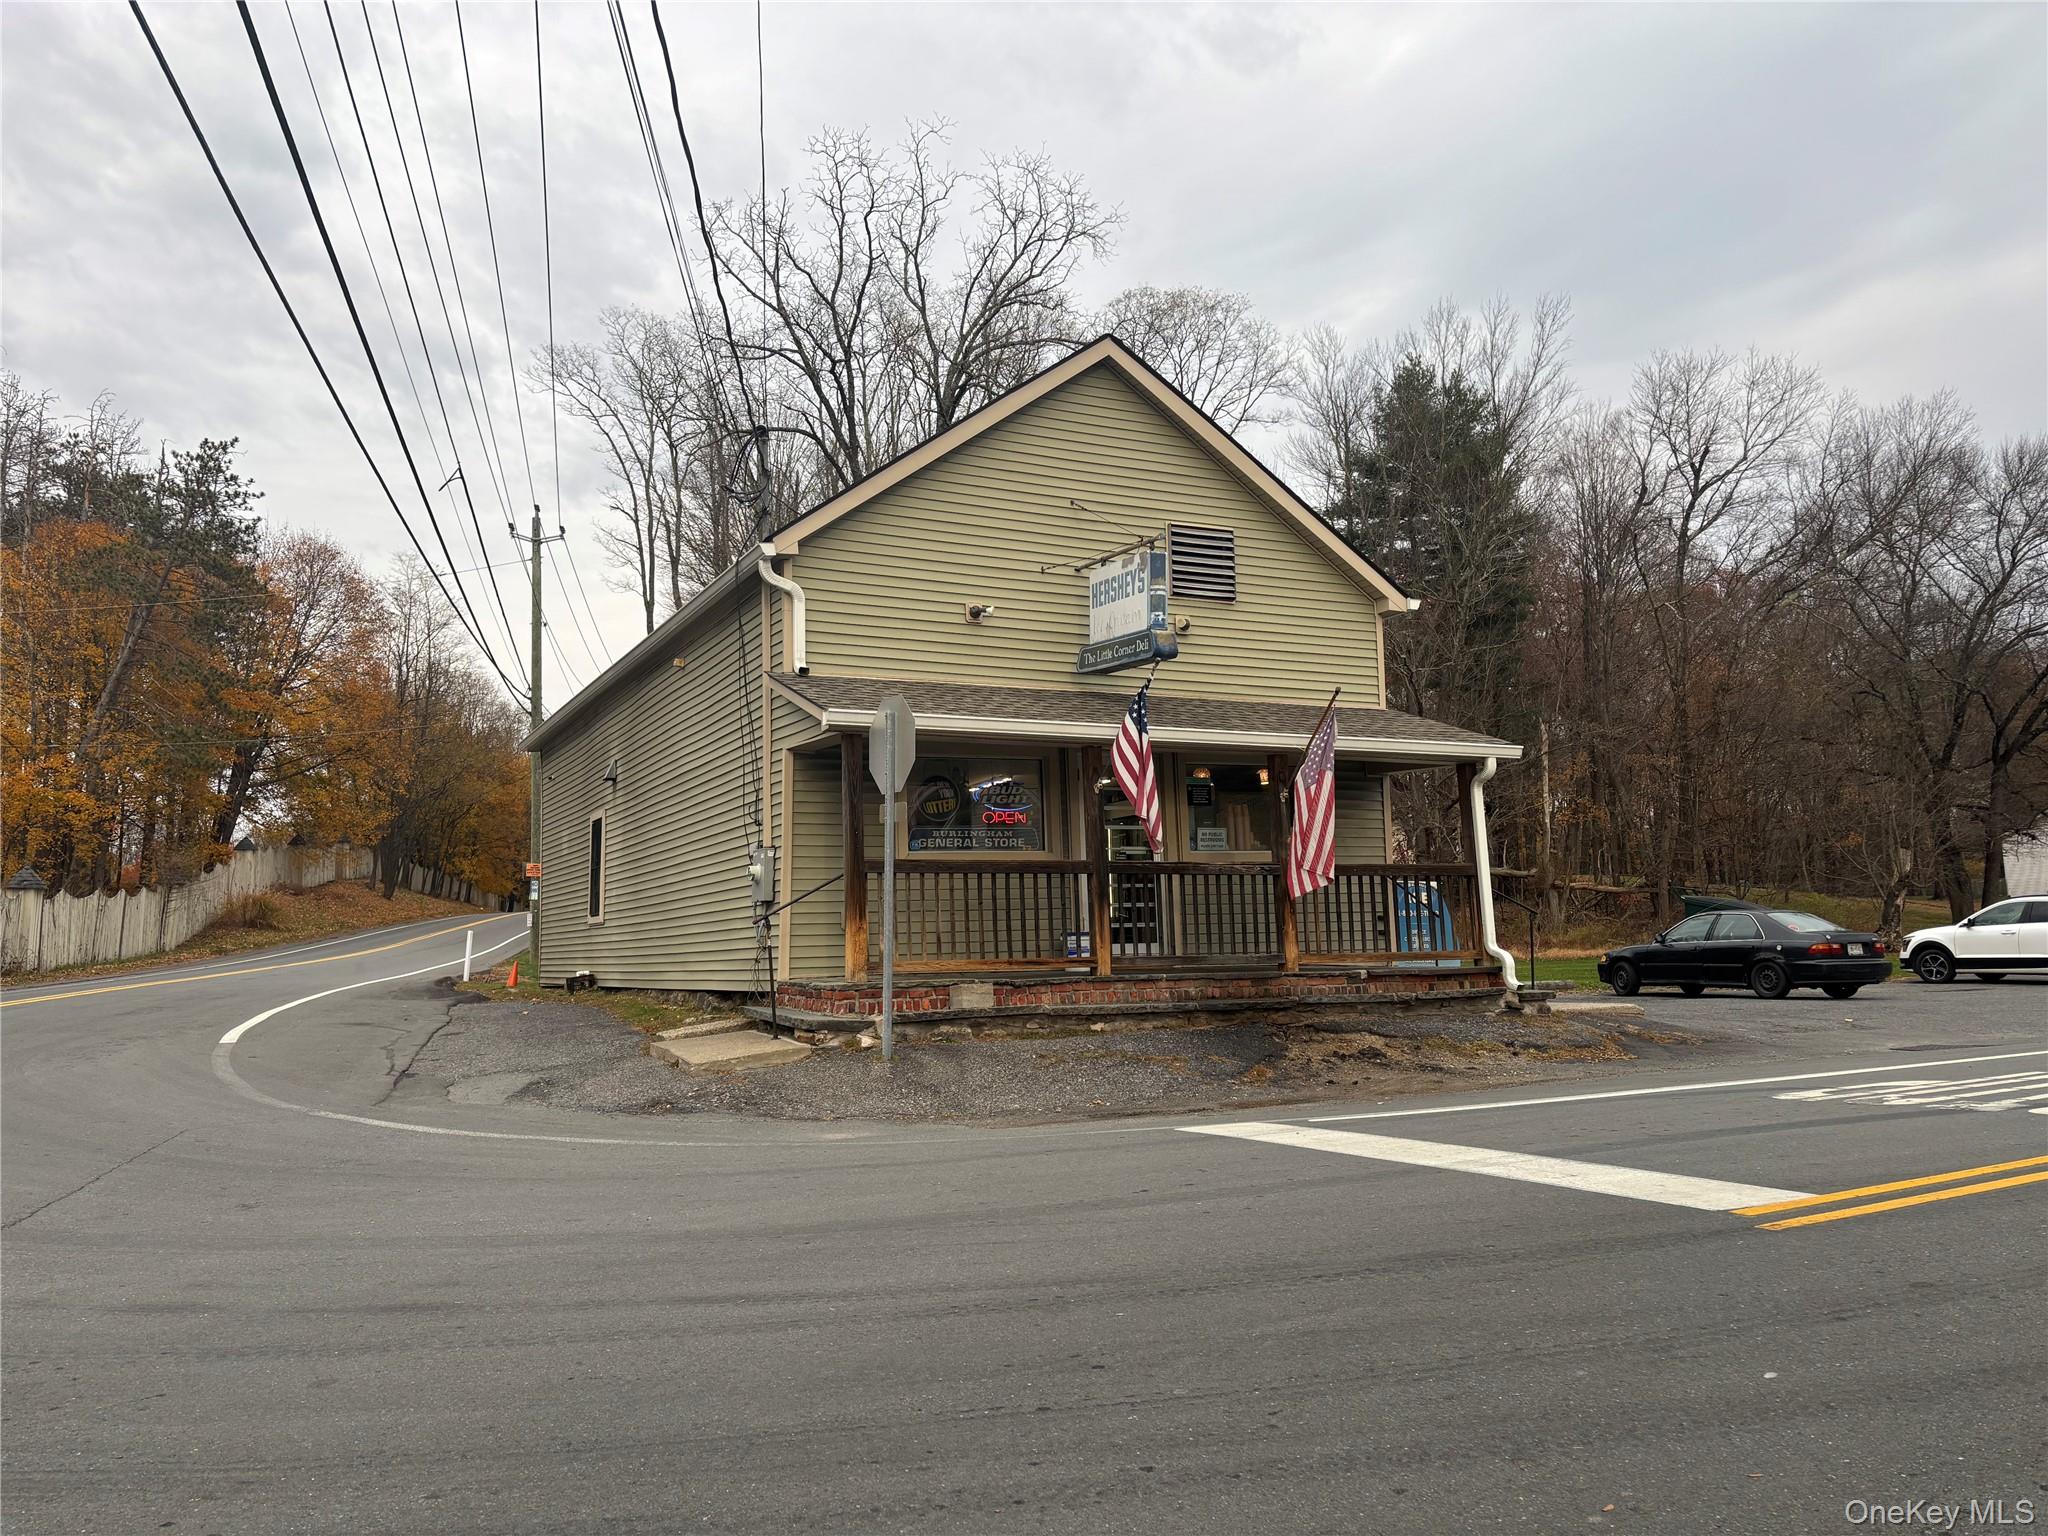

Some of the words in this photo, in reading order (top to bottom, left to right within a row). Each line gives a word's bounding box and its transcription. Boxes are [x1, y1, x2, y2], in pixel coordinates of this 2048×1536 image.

[1092, 566, 1145, 609] HERSHEY'S
[1083, 653, 1096, 665] The
[1097, 649, 1112, 662] Little
[1113, 644, 1135, 657] Corner
[1136, 638, 1149, 652] Deli
[989, 786, 1024, 795] BUD
[982, 811, 1026, 824] OPEN
[918, 838, 978, 847] GENERAL
[985, 838, 1024, 847] STORE
